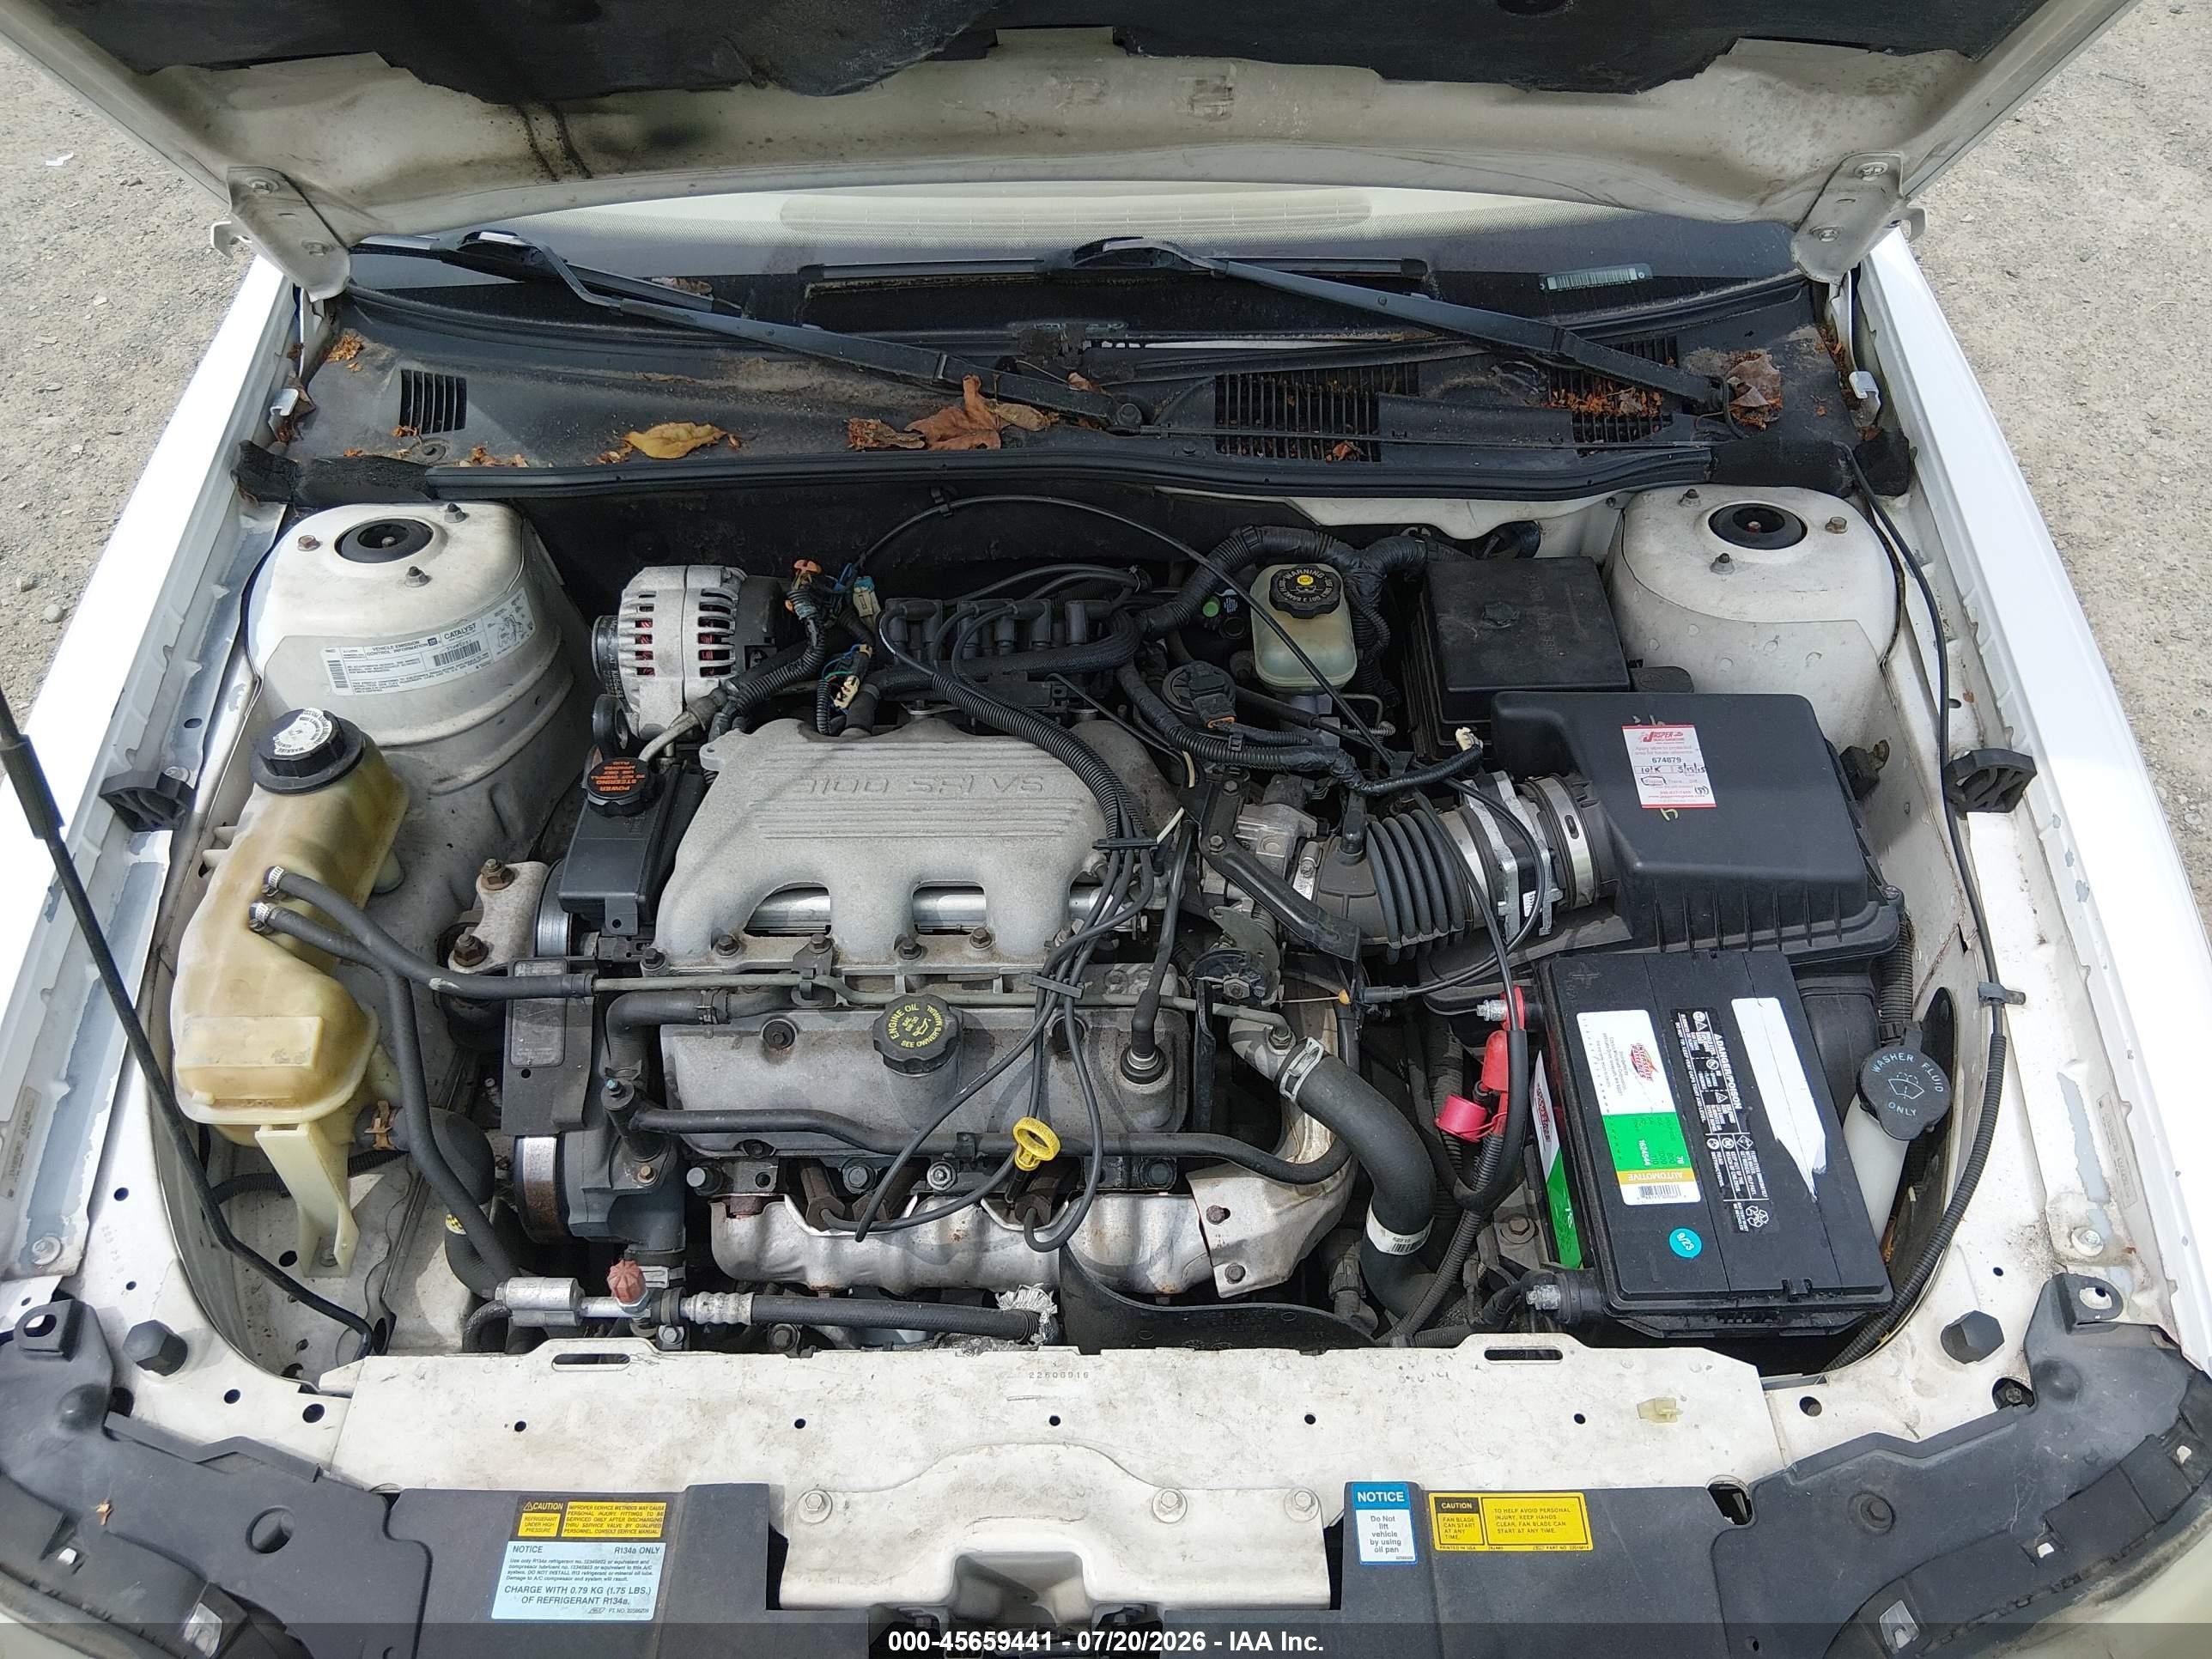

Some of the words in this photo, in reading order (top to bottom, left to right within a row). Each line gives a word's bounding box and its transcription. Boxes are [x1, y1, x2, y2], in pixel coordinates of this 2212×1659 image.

[1284, 568, 1326, 580] WARNING
[444, 623, 477, 640] CATALYST
[393, 643, 428, 653] INFORMATION
[1640, 731, 1675, 742] JASPER
[888, 1009, 905, 1040] ENGINE
[904, 1003, 919, 1012] OIL
[927, 1005, 942, 1026] MANUAL
[1680, 1046, 1689, 1058] KEEP
[1631, 1043, 1646, 1079] BATTERIES
[1637, 1043, 1653, 1080] INTERSTATE
[1684, 1058, 1692, 1070] VENT
[1687, 1070, 1696, 1083] CAPS
[1715, 1040, 1742, 1109] DANGER/POISON
[1871, 1052, 1914, 1073] WASHER
[1922, 1062, 1944, 1092] FLUID
[1703, 1073, 1712, 1087] FLAMES
[1691, 1084, 1700, 1097] TIGHT
[1888, 1102, 1917, 1116] ONLY
[1715, 1151, 1723, 1164] READ
[1724, 1151, 1733, 1165] REACH
[1729, 1151, 1738, 1163] KEEP
[1749, 1150, 1758, 1163] FLUSH
[1753, 1163, 1761, 1172] EYES
[1626, 1170, 1684, 1182] AUTOMOTIVE
[1755, 1172, 1768, 1197] IMMEDIATELY
[1736, 1201, 1746, 1220] BATTERY
[1357, 1492, 1406, 1503] NOTICE
[513, 1545, 544, 1553] NOTICE
[504, 1585, 543, 1594] CHARGE
[606, 1587, 626, 1595] (1.75
[629, 1587, 652, 1595] LBS.)
[537, 1596, 600, 1605] REFRIGERANT
